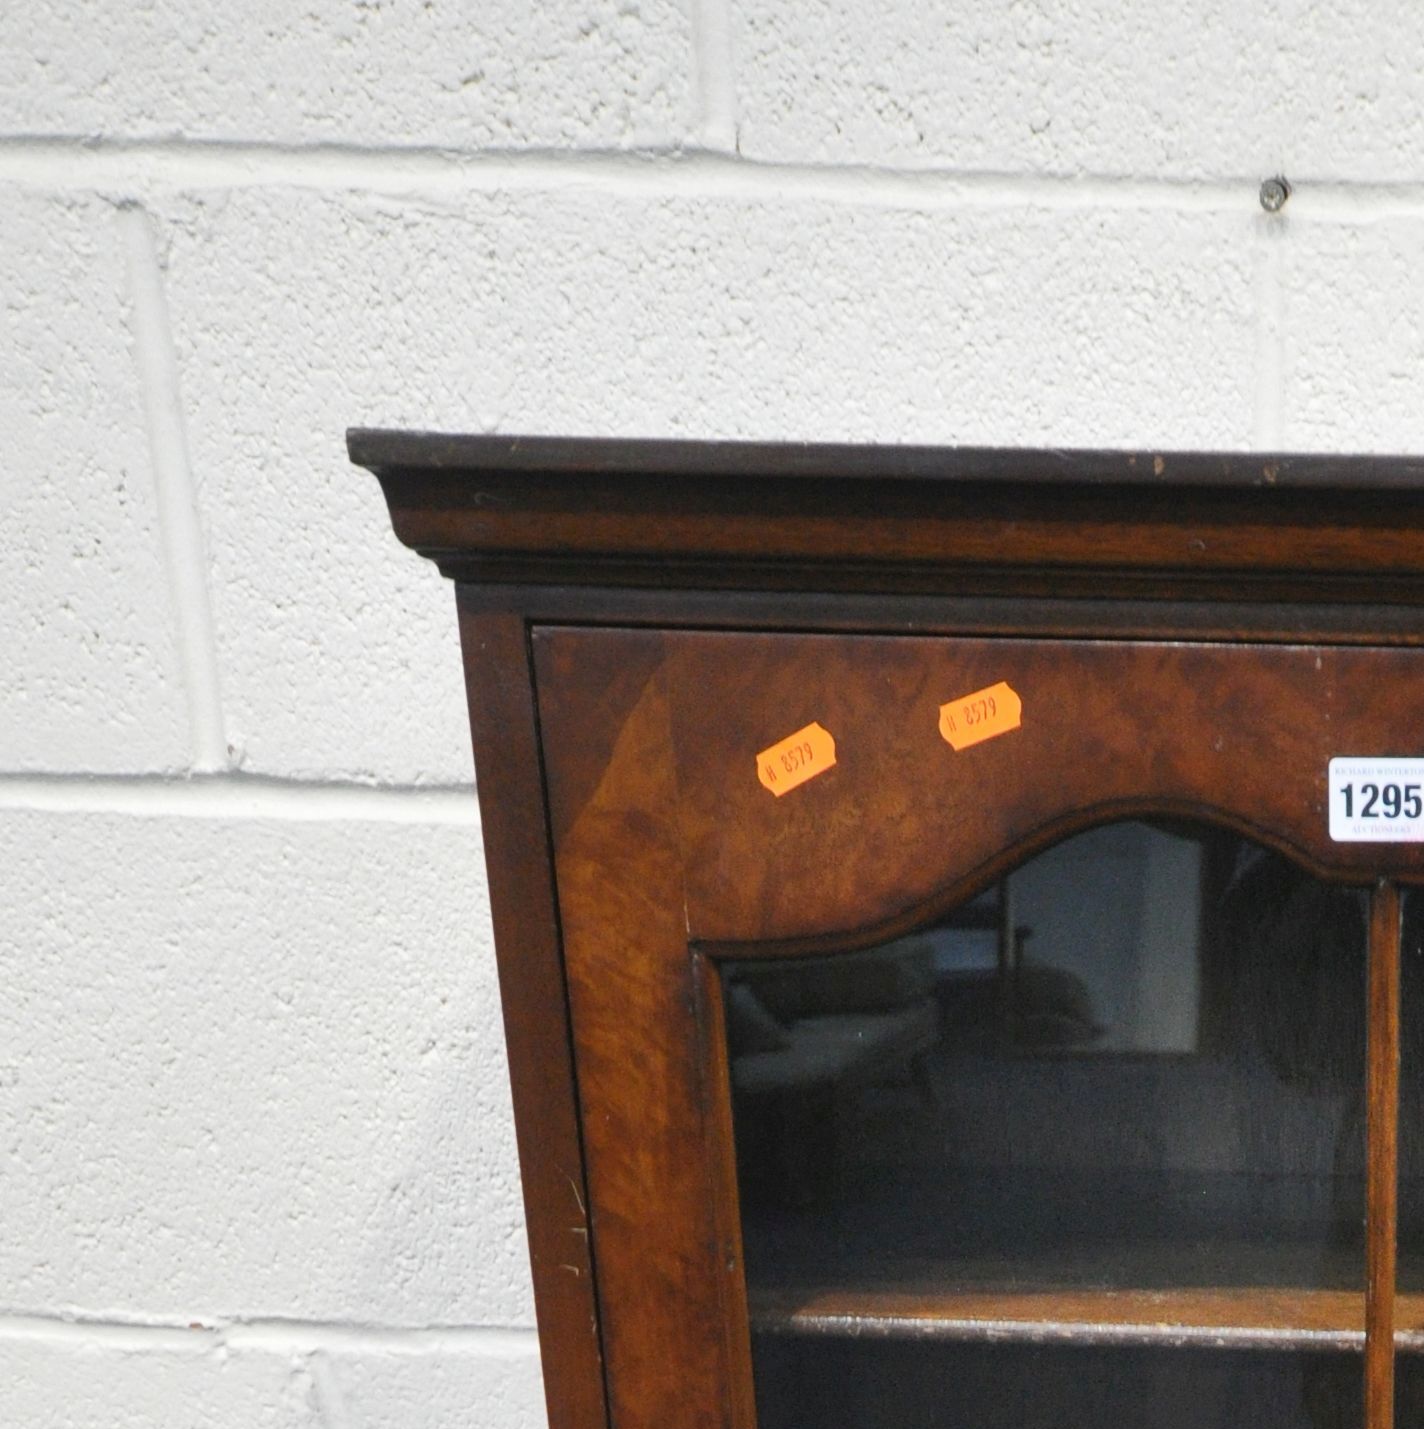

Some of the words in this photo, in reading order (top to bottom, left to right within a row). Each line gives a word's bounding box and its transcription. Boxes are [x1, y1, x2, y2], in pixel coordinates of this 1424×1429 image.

[963, 696, 997, 725] 8579
[781, 742, 813, 773] 8579
[1335, 767, 1374, 776] RICHARD
[1340, 783, 1422, 819] 1295
